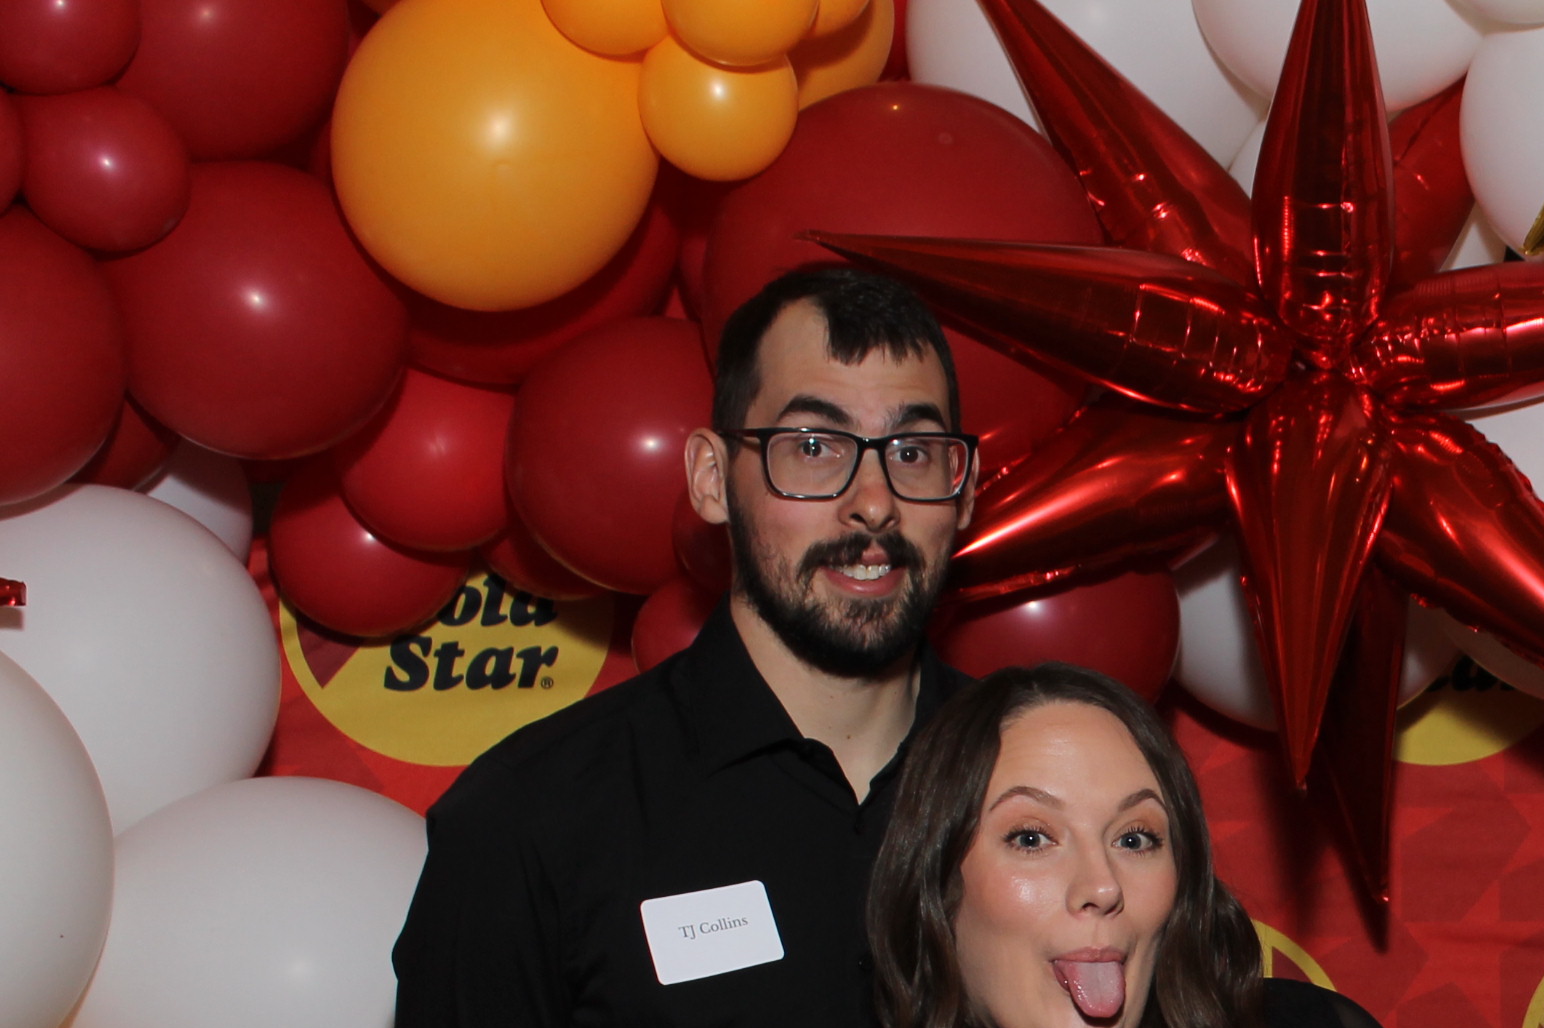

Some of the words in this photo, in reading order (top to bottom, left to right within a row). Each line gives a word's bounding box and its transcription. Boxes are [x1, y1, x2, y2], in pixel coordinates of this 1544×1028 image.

[437, 570, 558, 627] old
[678, 924, 697, 940] TJ
[700, 917, 749, 935] Collins
